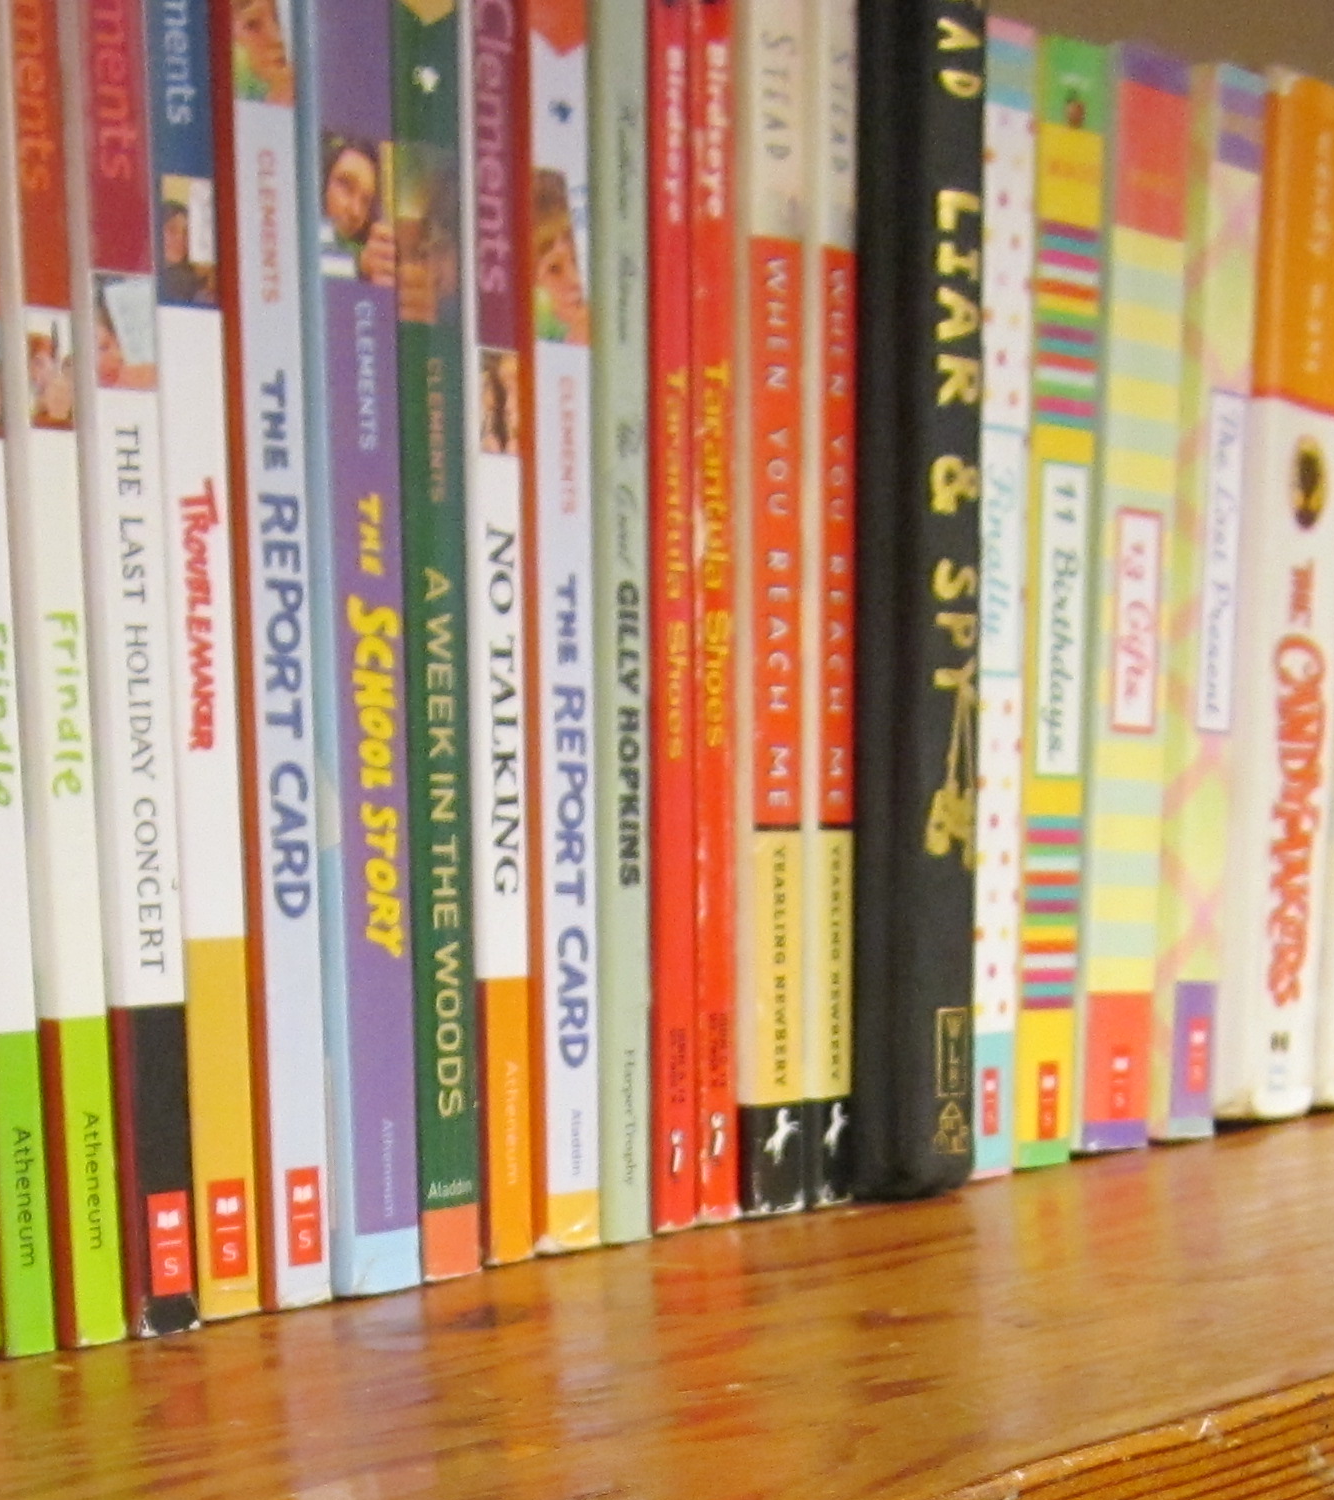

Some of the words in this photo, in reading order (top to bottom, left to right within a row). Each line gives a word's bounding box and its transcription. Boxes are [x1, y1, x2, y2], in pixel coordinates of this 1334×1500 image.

[765, 258, 790, 390] WHEN
[935, 188, 982, 405] LIAR
[262, 369, 291, 470] THE
[353, 301, 377, 451] CLEMENTS
[114, 425, 141, 496] THE
[767, 429, 789, 516] YOU
[929, 455, 978, 515] &
[119, 521, 148, 603] LAST
[259, 493, 304, 738] REPORT
[424, 567, 452, 600] A
[487, 523, 515, 616] NO
[554, 573, 579, 663] THE
[766, 549, 791, 713] REACH
[43, 606, 86, 799] frindle
[123, 624, 157, 781] HOLIDAY
[347, 595, 403, 790] SCHOOL
[428, 614, 455, 759] WEEK
[614, 581, 640, 694] GILLY
[1041, 549, 1077, 760] Birthdays
[270, 761, 310, 920] CARD
[430, 773, 457, 822] IN
[489, 643, 521, 895] TALKING
[551, 687, 587, 905] REPORT
[617, 706, 642, 886] HOPKINS
[770, 747, 791, 807] ME
[132, 795, 168, 975] CONCERT
[359, 803, 404, 958] STORY
[433, 841, 460, 931] THE
[773, 845, 787, 965] YEARLING
[434, 943, 465, 1117] WOODS
[557, 926, 591, 1069] CARD
[774, 976, 788, 1087] NEWBERY
[12, 1126, 36, 1269] Atheneum
[82, 1109, 105, 1251] Atheneum
